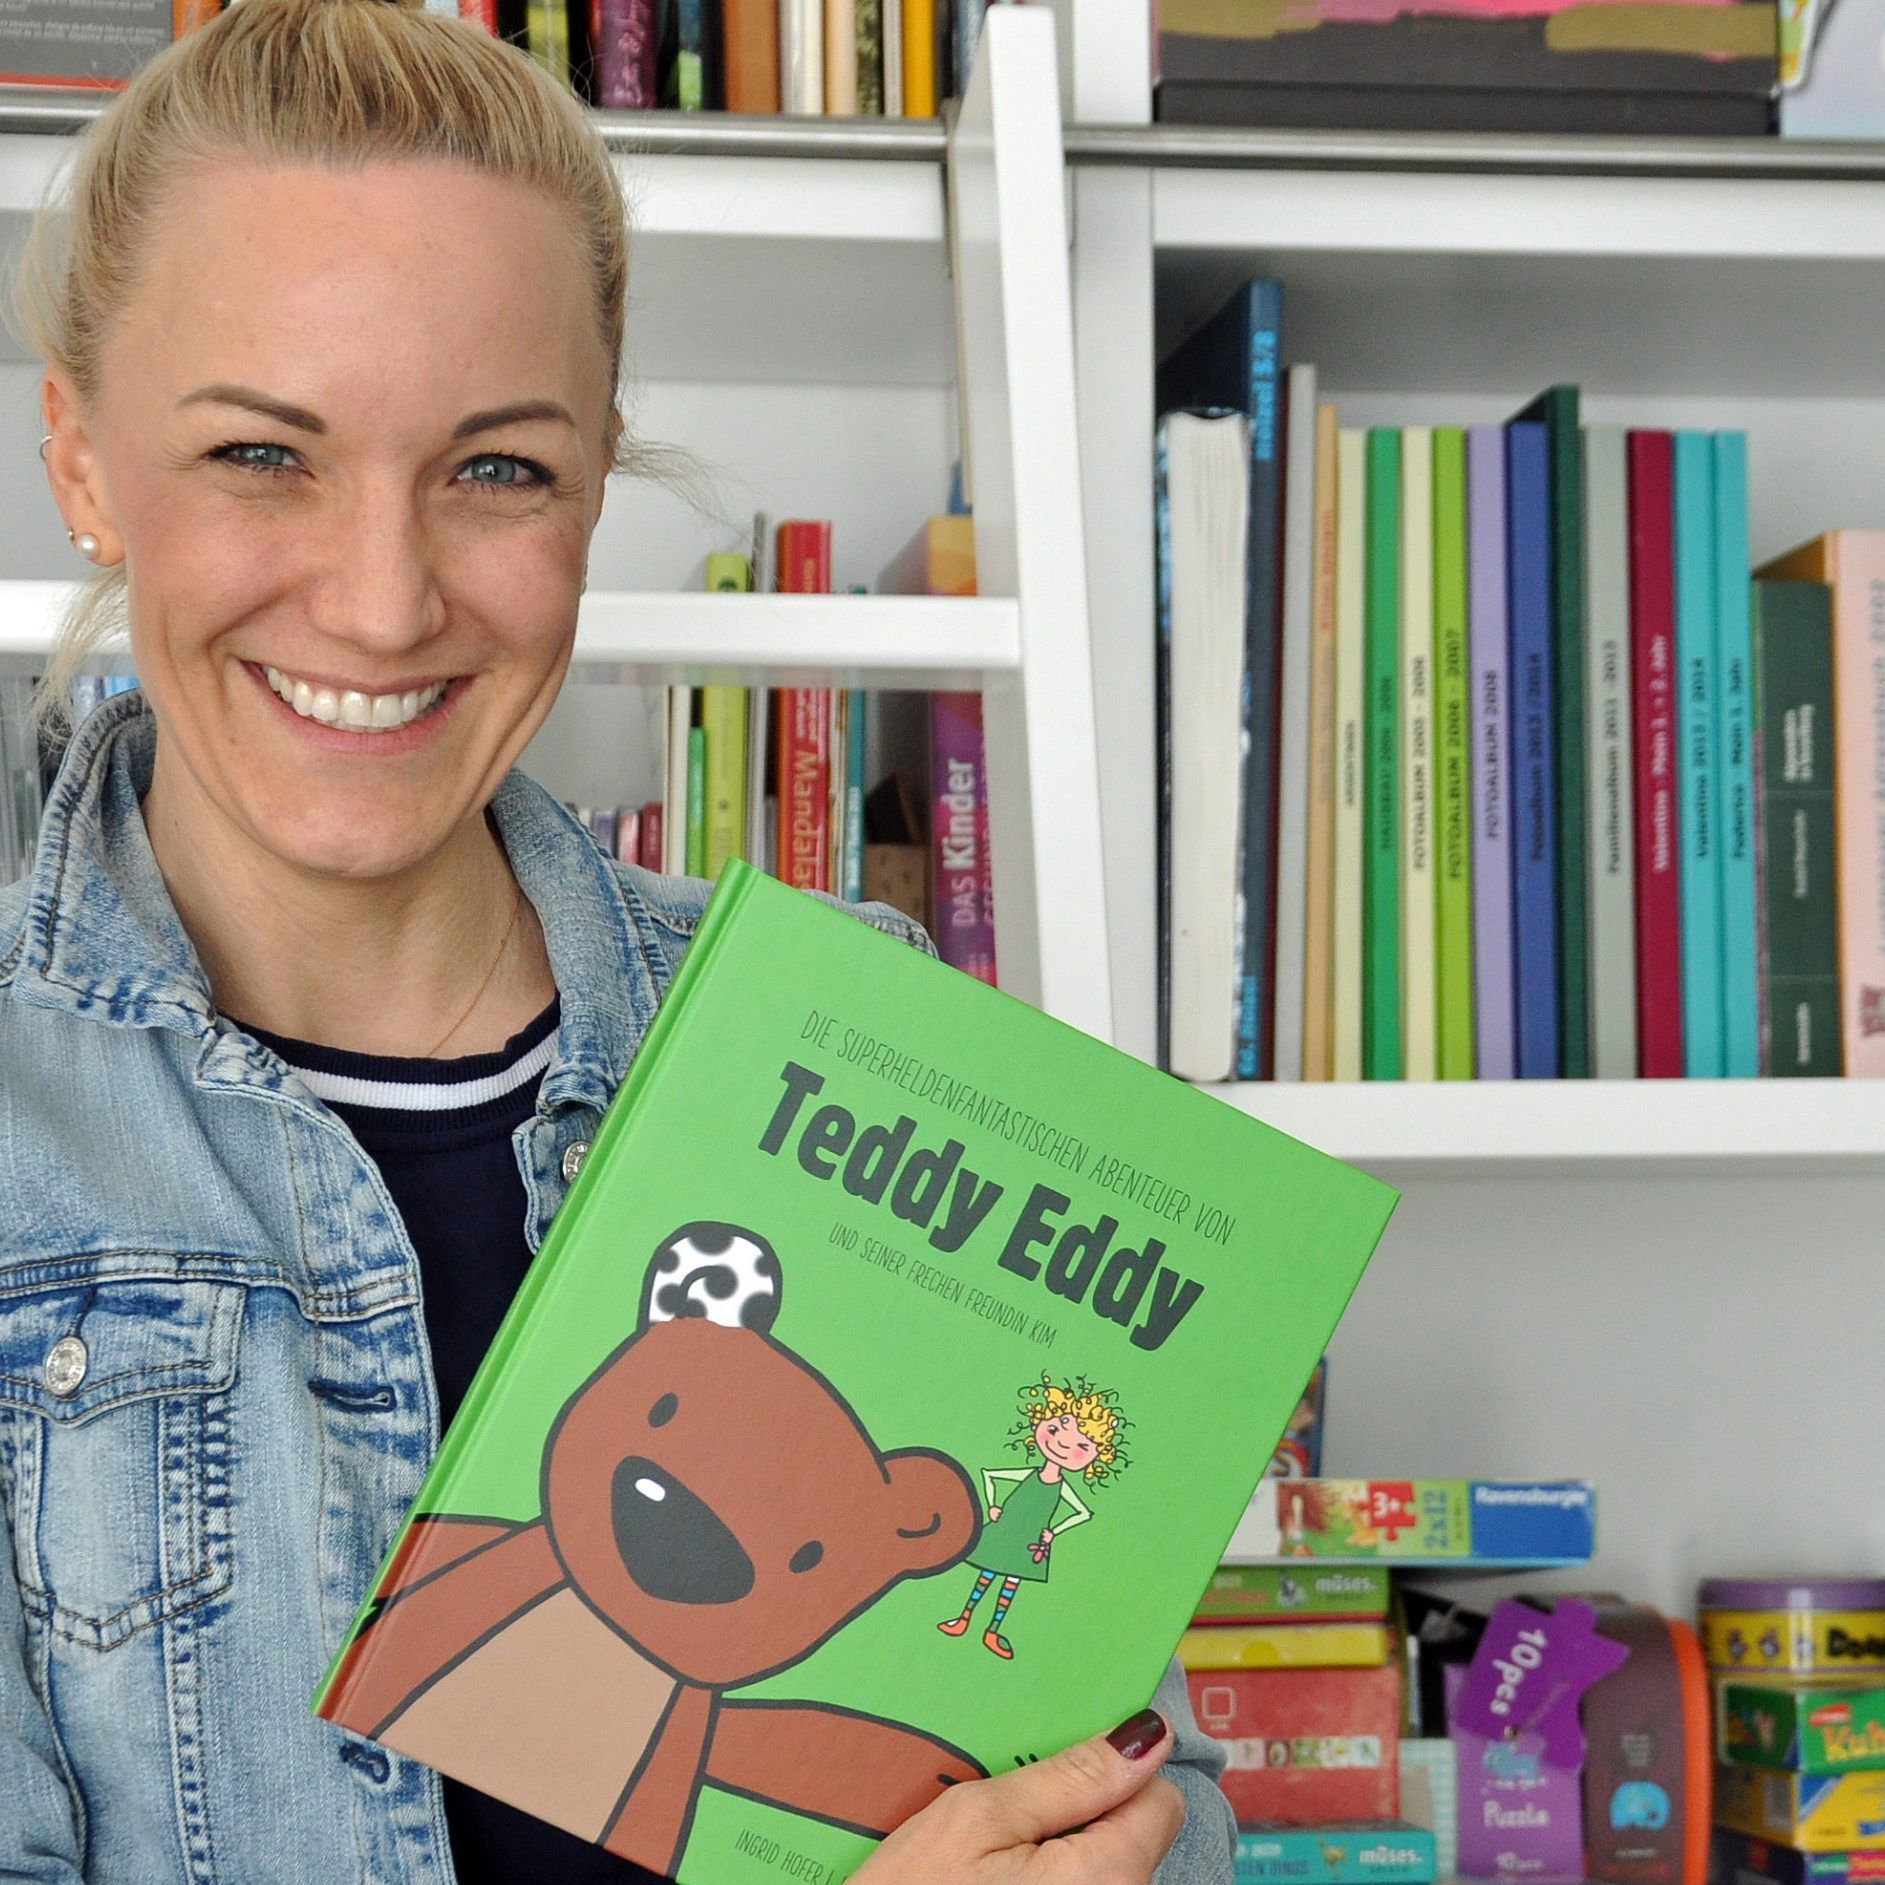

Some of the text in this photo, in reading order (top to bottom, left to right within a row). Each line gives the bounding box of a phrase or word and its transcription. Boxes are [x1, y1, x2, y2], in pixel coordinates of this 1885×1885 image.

[941, 758, 976, 929] DAS Kinder
[1446, 757, 1461, 880] FOTOALBUM
[1485, 723, 1500, 840] FOTOALBUM
[801, 1009, 1237, 1246] DIE SUPERHELDENFANTASTISCHEN ABENTEUER VON
[757, 1060, 1205, 1352] Teddy Eddy
[829, 1222, 1058, 1349] UND SEINER FRECHEN FREUNDIN KIM
[1373, 1490, 1401, 1518] 3+
[735, 1828, 780, 1865] INGRID
[780, 1850, 824, 1885] HOFER
